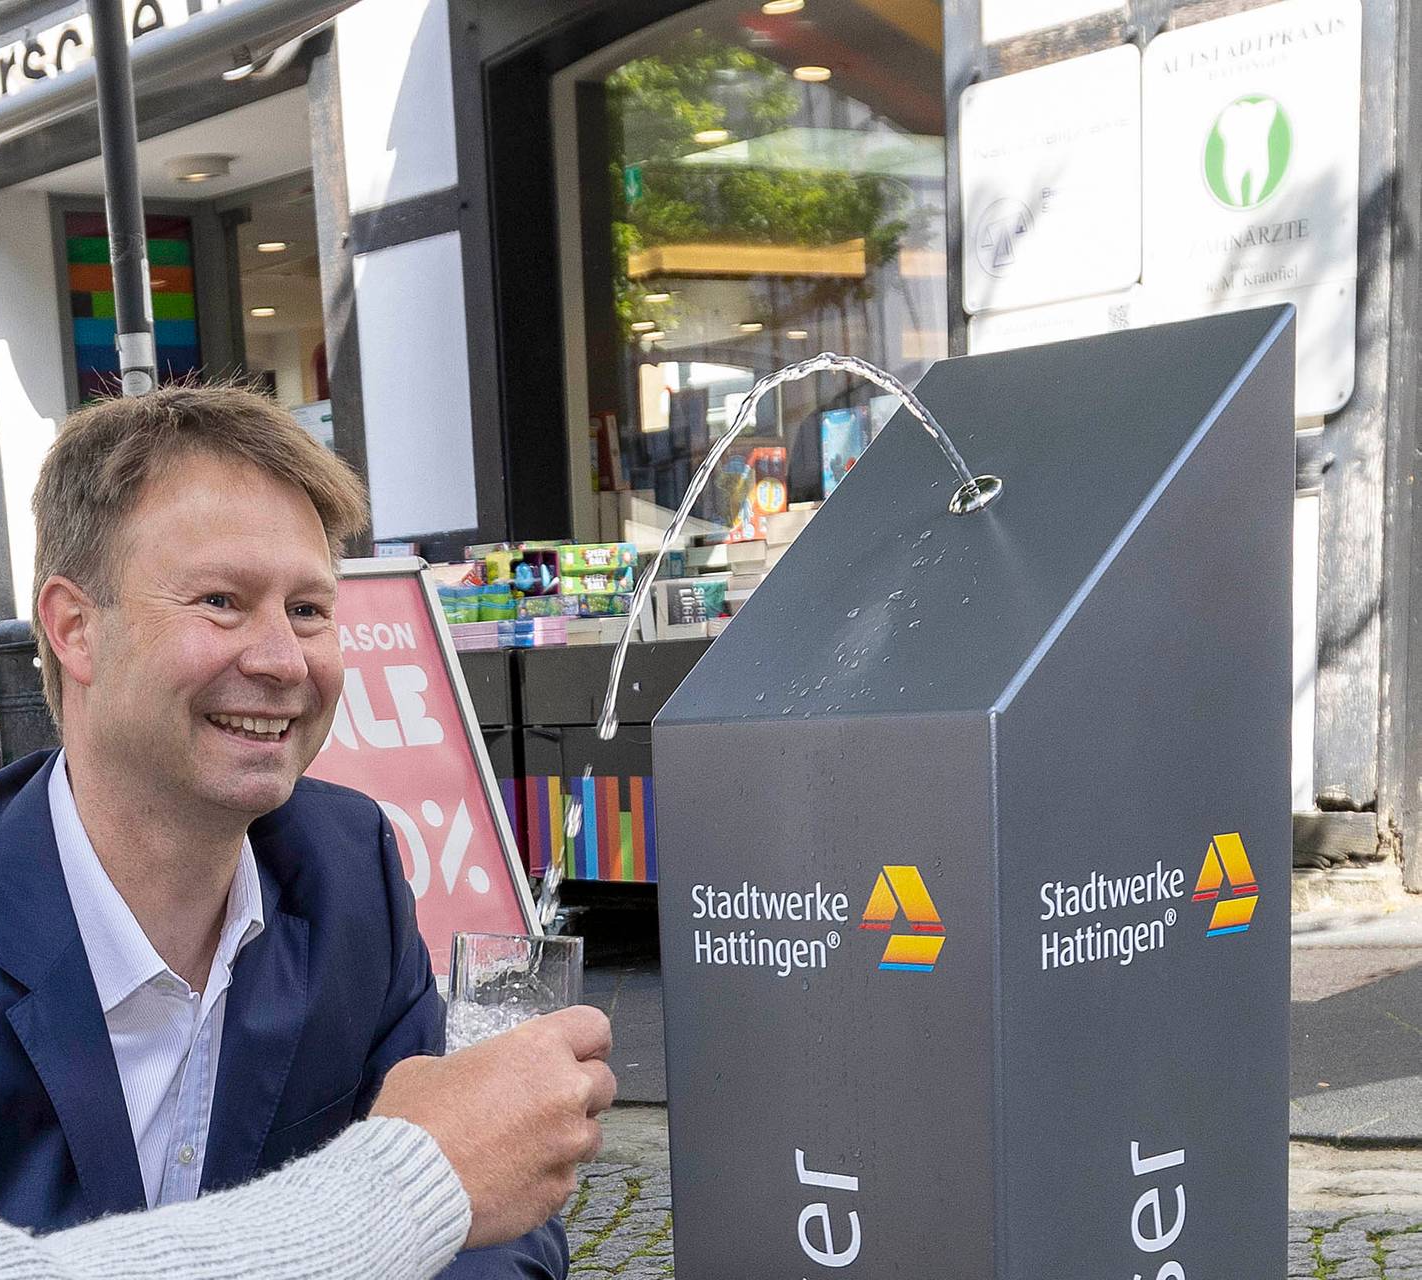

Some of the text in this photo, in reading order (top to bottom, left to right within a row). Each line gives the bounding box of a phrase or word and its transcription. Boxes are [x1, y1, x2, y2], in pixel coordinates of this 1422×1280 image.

[338, 623, 417, 652] ASON
[691, 881, 849, 922] Stadtwerke
[1040, 860, 1185, 920] Stadtwerke
[795, 1148, 862, 1280] er
